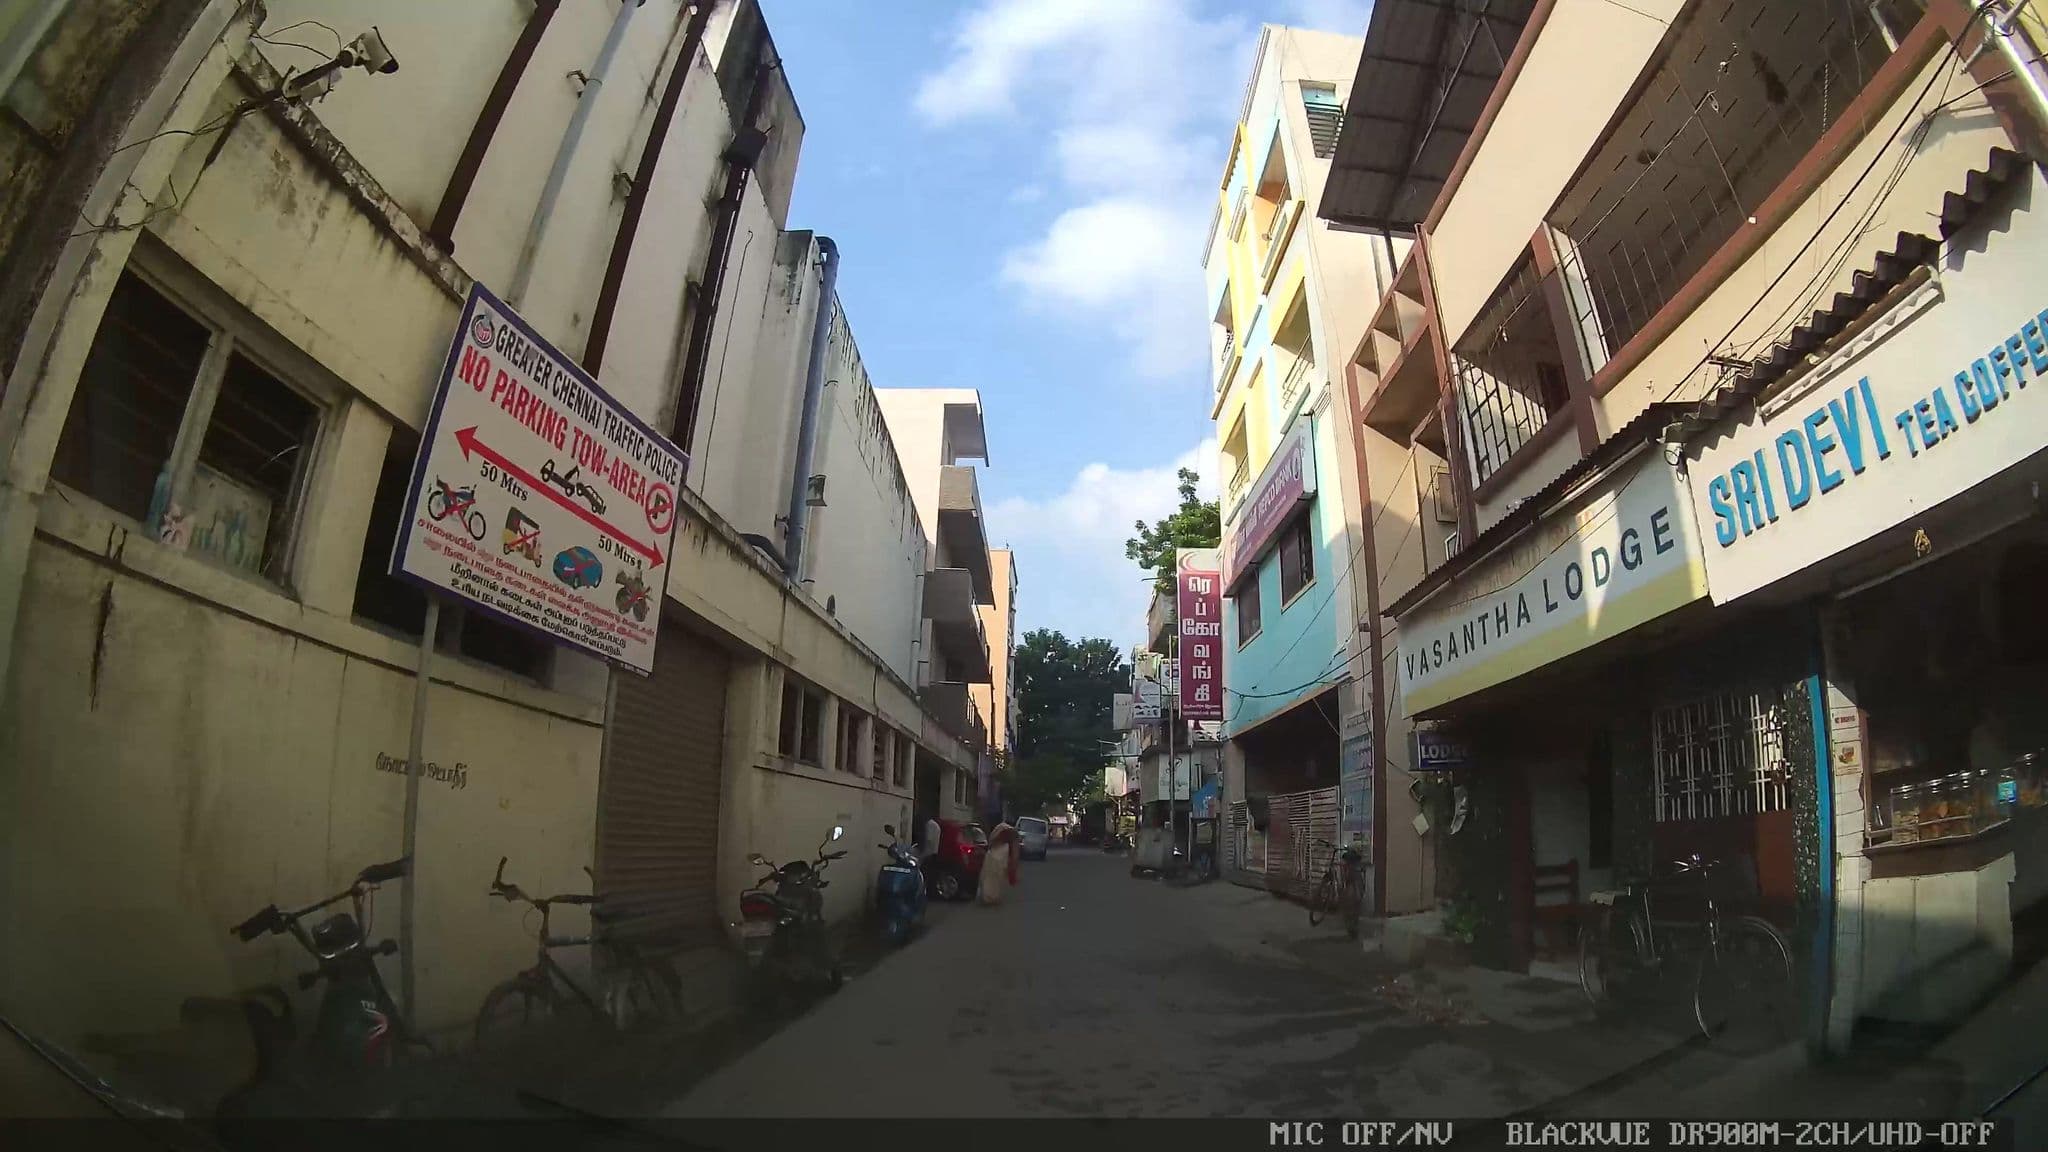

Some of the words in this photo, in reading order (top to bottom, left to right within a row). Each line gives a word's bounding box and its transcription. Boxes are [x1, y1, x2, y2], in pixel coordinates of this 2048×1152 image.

[458, 344, 490, 393] NO
[490, 367, 568, 448] PARKING
[570, 426, 646, 506] TOW-AREA
[480, 461, 498, 483] 50
[499, 472, 529, 501] Mtrs
[496, 324, 552, 390] GREATER
[552, 370, 602, 428] CHENNAI
[603, 408, 645, 460] TRAFFIC
[645, 446, 678, 486] POLICE
[1708, 446, 1779, 548] SRI
[1777, 375, 1892, 511] DEVI
[1895, 386, 1958, 458] TEA
[598, 533, 614, 555] 50
[615, 542, 636, 568] Mtrs
[1405, 589, 1532, 681] VASANTHA
[1542, 505, 1676, 613] LODGE
